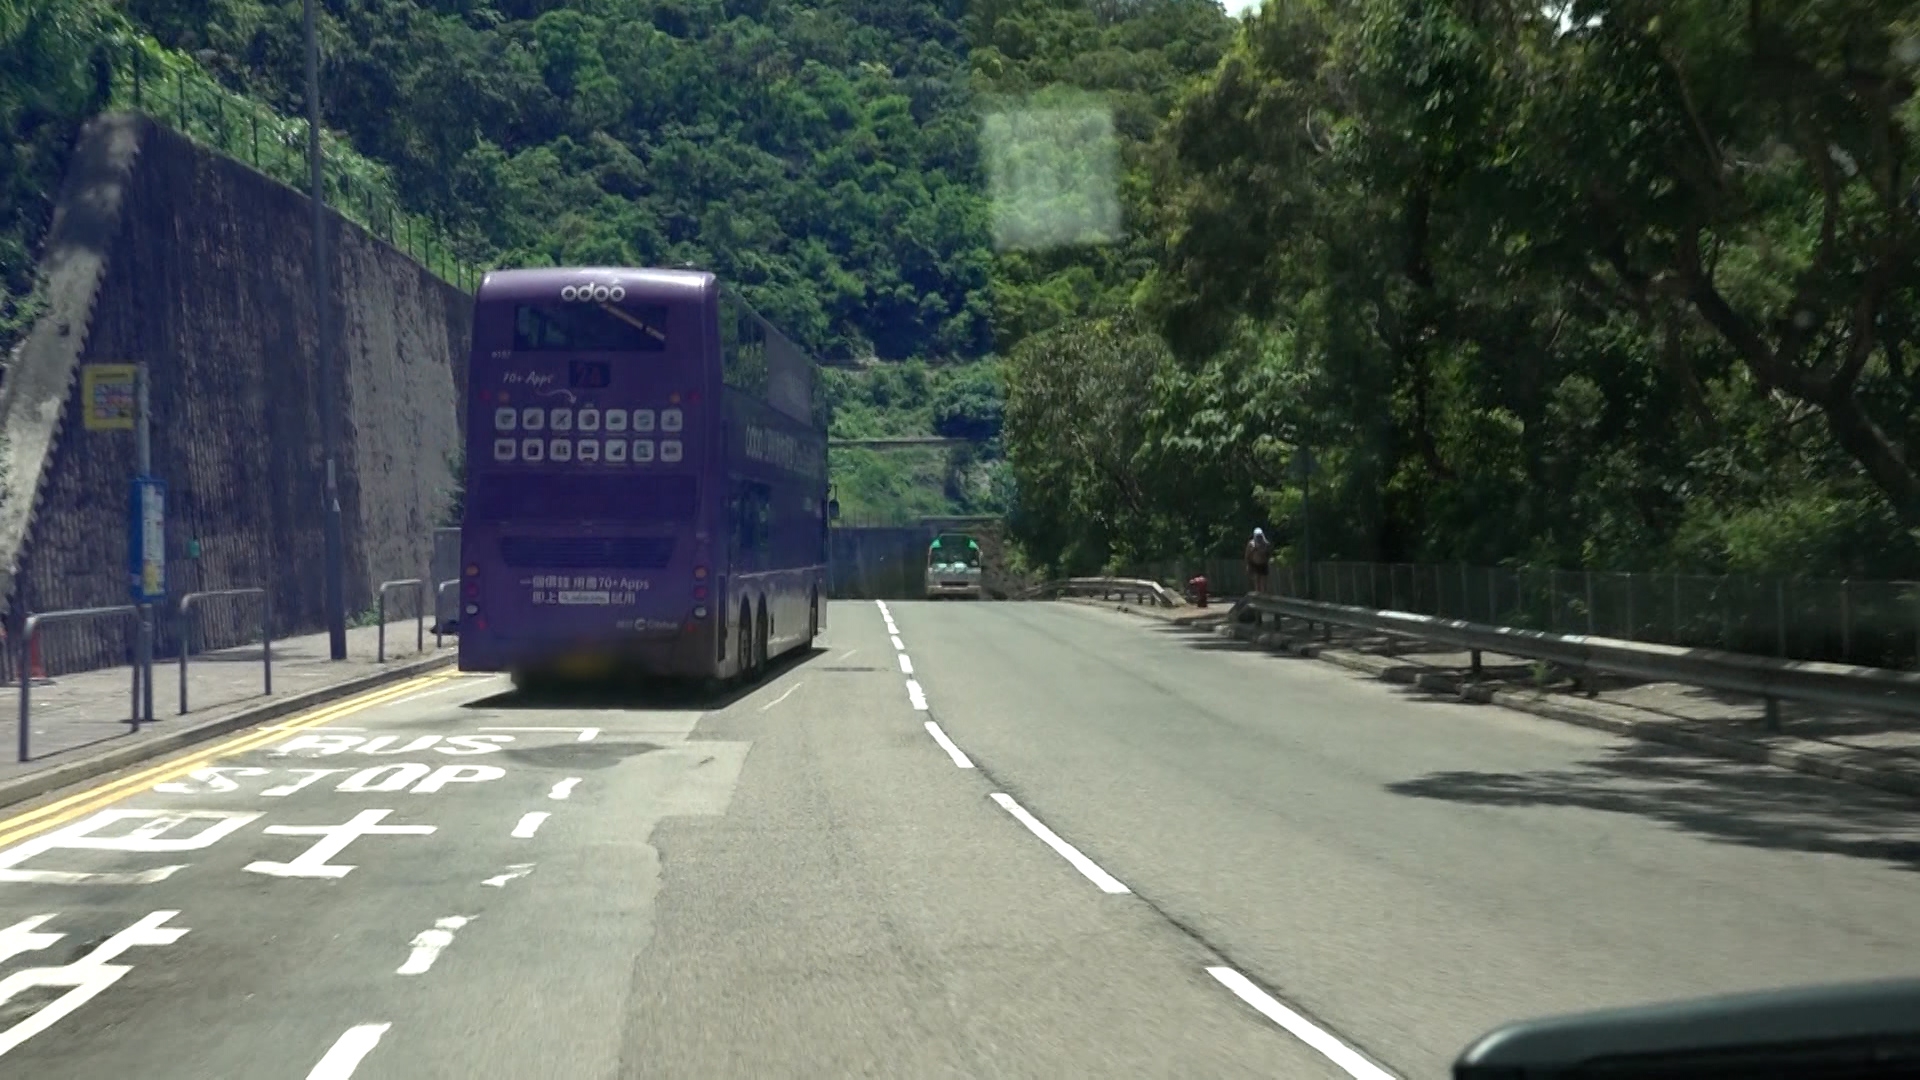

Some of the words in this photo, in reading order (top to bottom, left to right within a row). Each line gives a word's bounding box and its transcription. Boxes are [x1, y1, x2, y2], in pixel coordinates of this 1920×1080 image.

[561, 282, 626, 302] odoo
[275, 734, 515, 755] BUS
[153, 763, 506, 796] STOP
